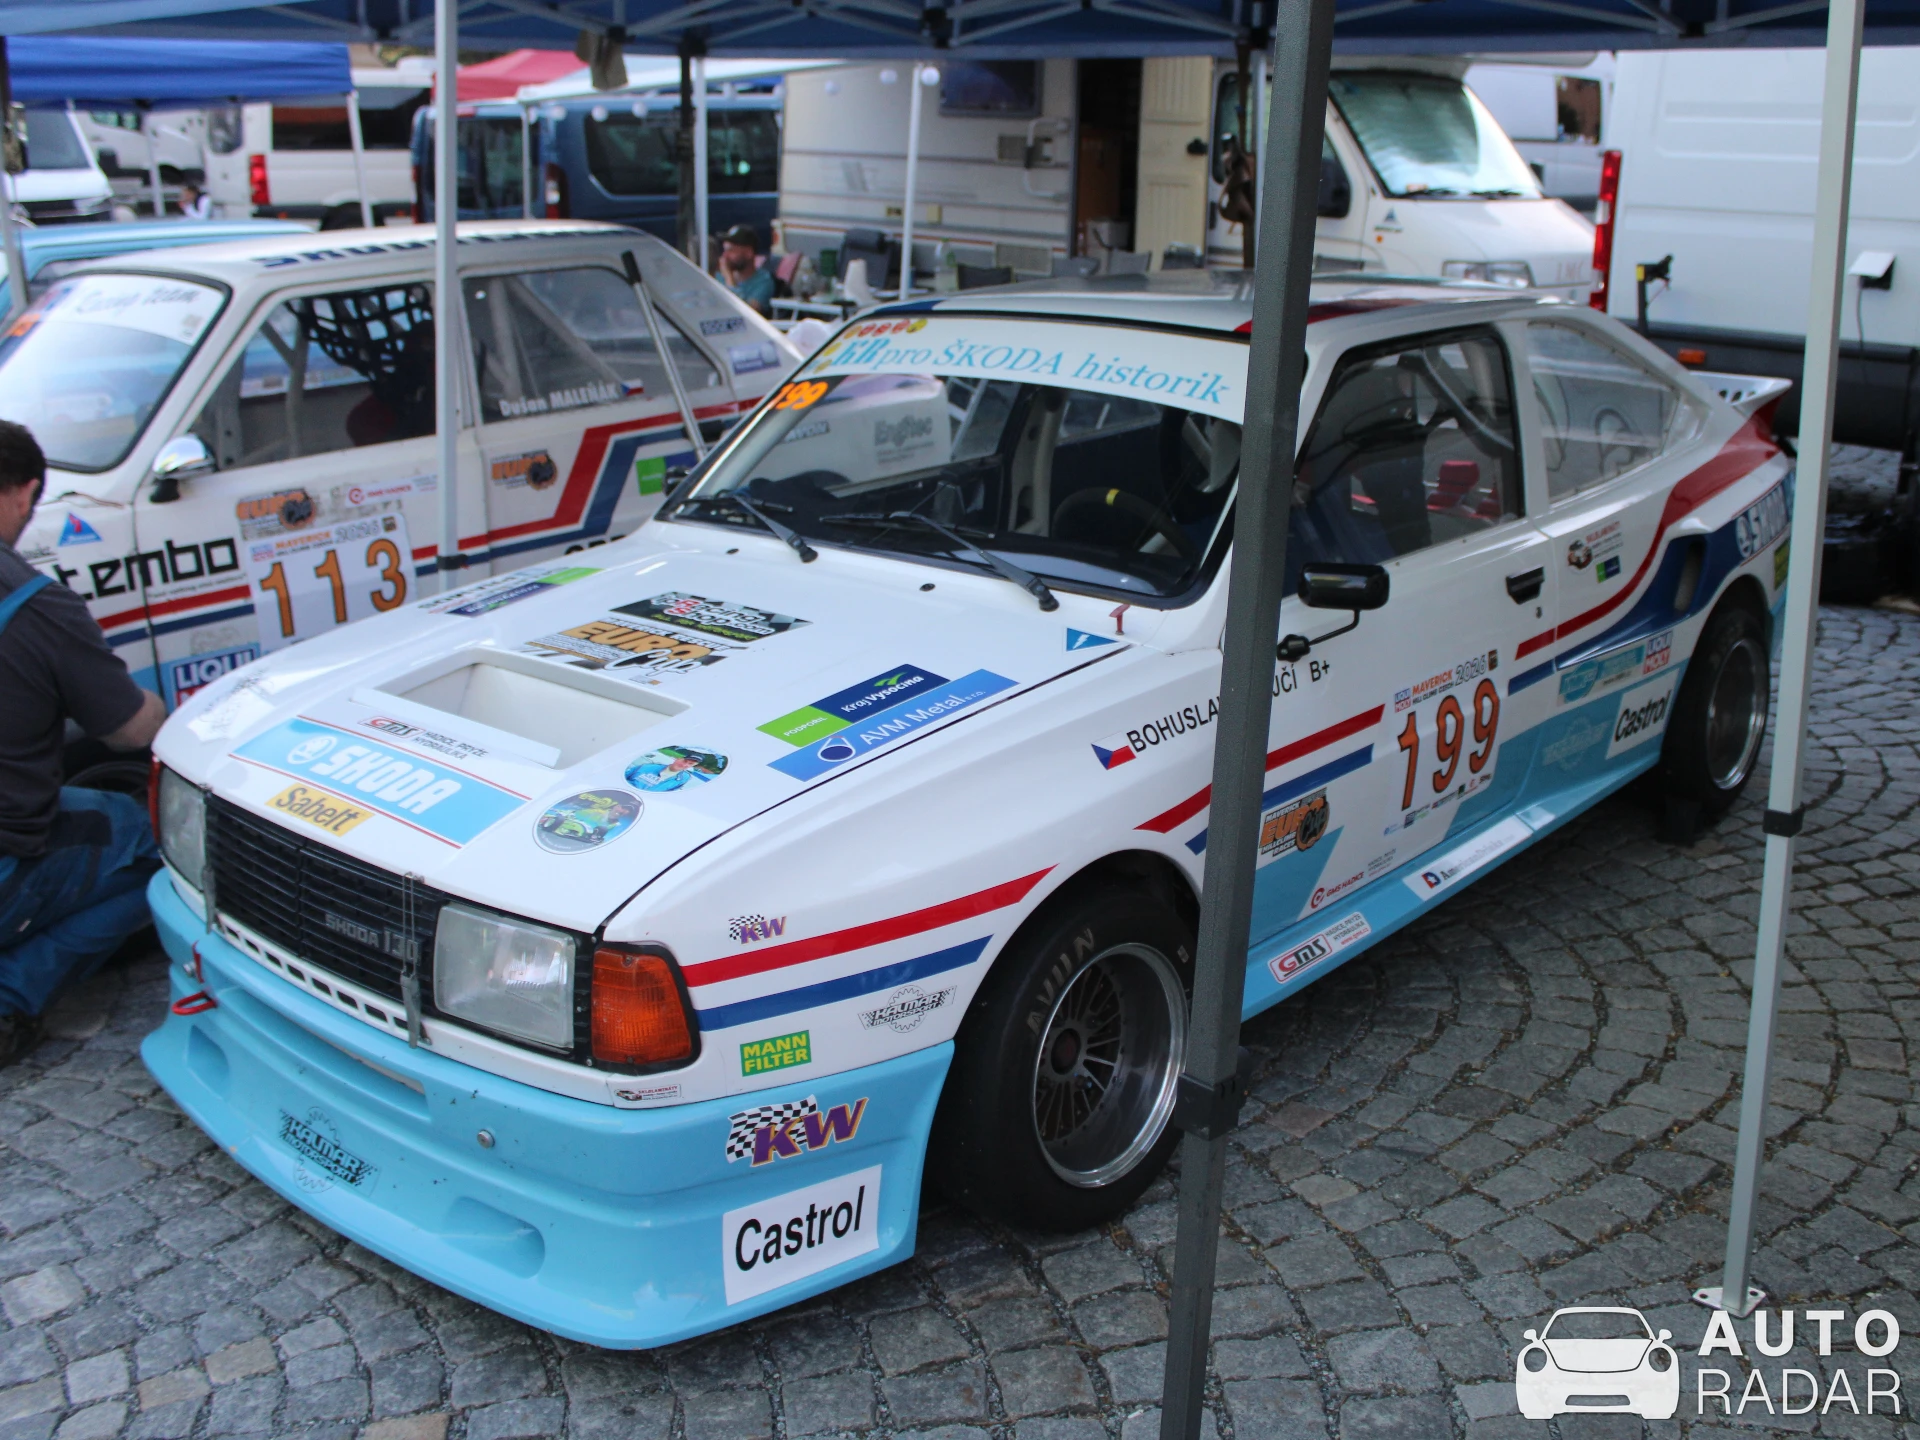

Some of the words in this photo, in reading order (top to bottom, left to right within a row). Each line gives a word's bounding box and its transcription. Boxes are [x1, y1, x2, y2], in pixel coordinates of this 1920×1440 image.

[933, 338, 1064, 375] ŠKODA
[1072, 352, 1232, 404] historik
[765, 381, 829, 412] 199
[53, 537, 239, 600] tembo
[259, 538, 407, 638] 113
[559, 621, 712, 661] EURO
[604, 648, 702, 677] Cup
[1412, 669, 1453, 696] MAVERICK
[1455, 654, 1486, 687] 2026
[859, 718, 912, 745] AVM
[904, 694, 967, 723] Metal
[1126, 696, 1221, 753] BOHUSLA
[1309, 659, 1331, 683] B+
[1613, 688, 1673, 742] Castrol
[414, 736, 469, 760] HYDRAULIKA
[425, 731, 458, 747] HADICE
[1397, 677, 1501, 813] 199
[275, 787, 360, 832] Sabelt
[739, 915, 788, 945] KW
[873, 1003, 940, 1027] MOTORSPORT
[874, 992, 942, 1020] KALMAR
[743, 1033, 808, 1059] MANN
[744, 1048, 810, 1074] FILTER
[289, 1118, 363, 1174] KALMAR
[751, 1097, 870, 1168] KW
[284, 1132, 354, 1184] MOTORSPORT
[734, 1184, 867, 1272] Castrol
